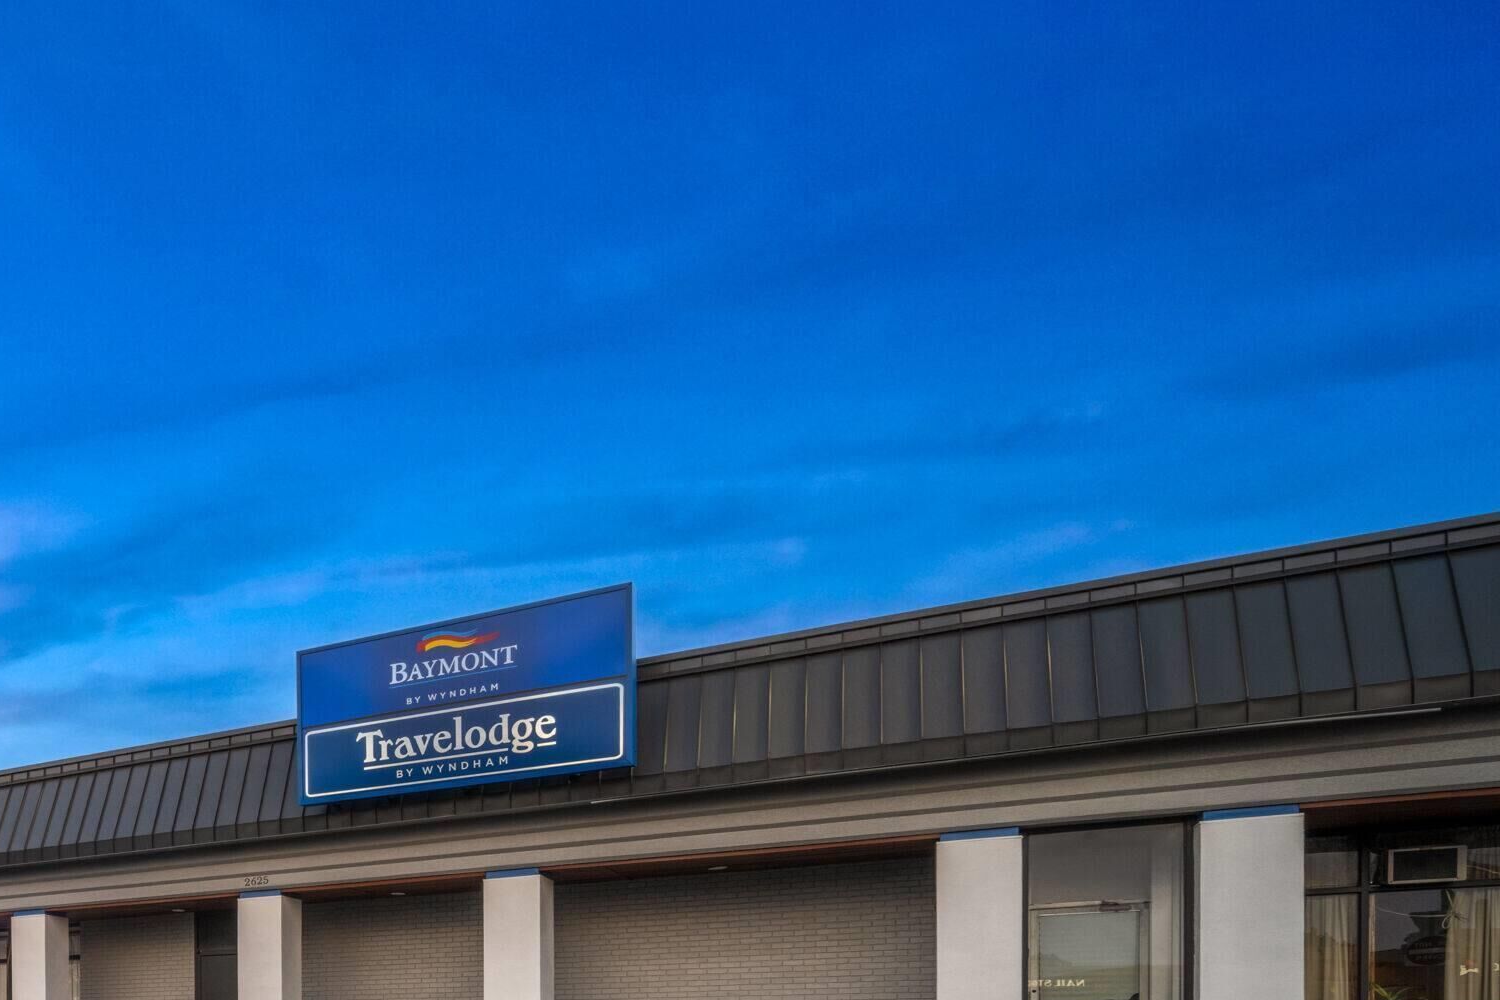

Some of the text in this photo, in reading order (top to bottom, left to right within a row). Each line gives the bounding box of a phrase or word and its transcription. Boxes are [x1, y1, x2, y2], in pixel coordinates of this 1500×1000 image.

[389, 644, 518, 685] BAYMONT
[406, 683, 499, 706] BY WYNDHAM
[356, 713, 557, 763] Travelodge
[396, 756, 509, 779] BY WYNDHAM
[244, 875, 269, 887] 2625
